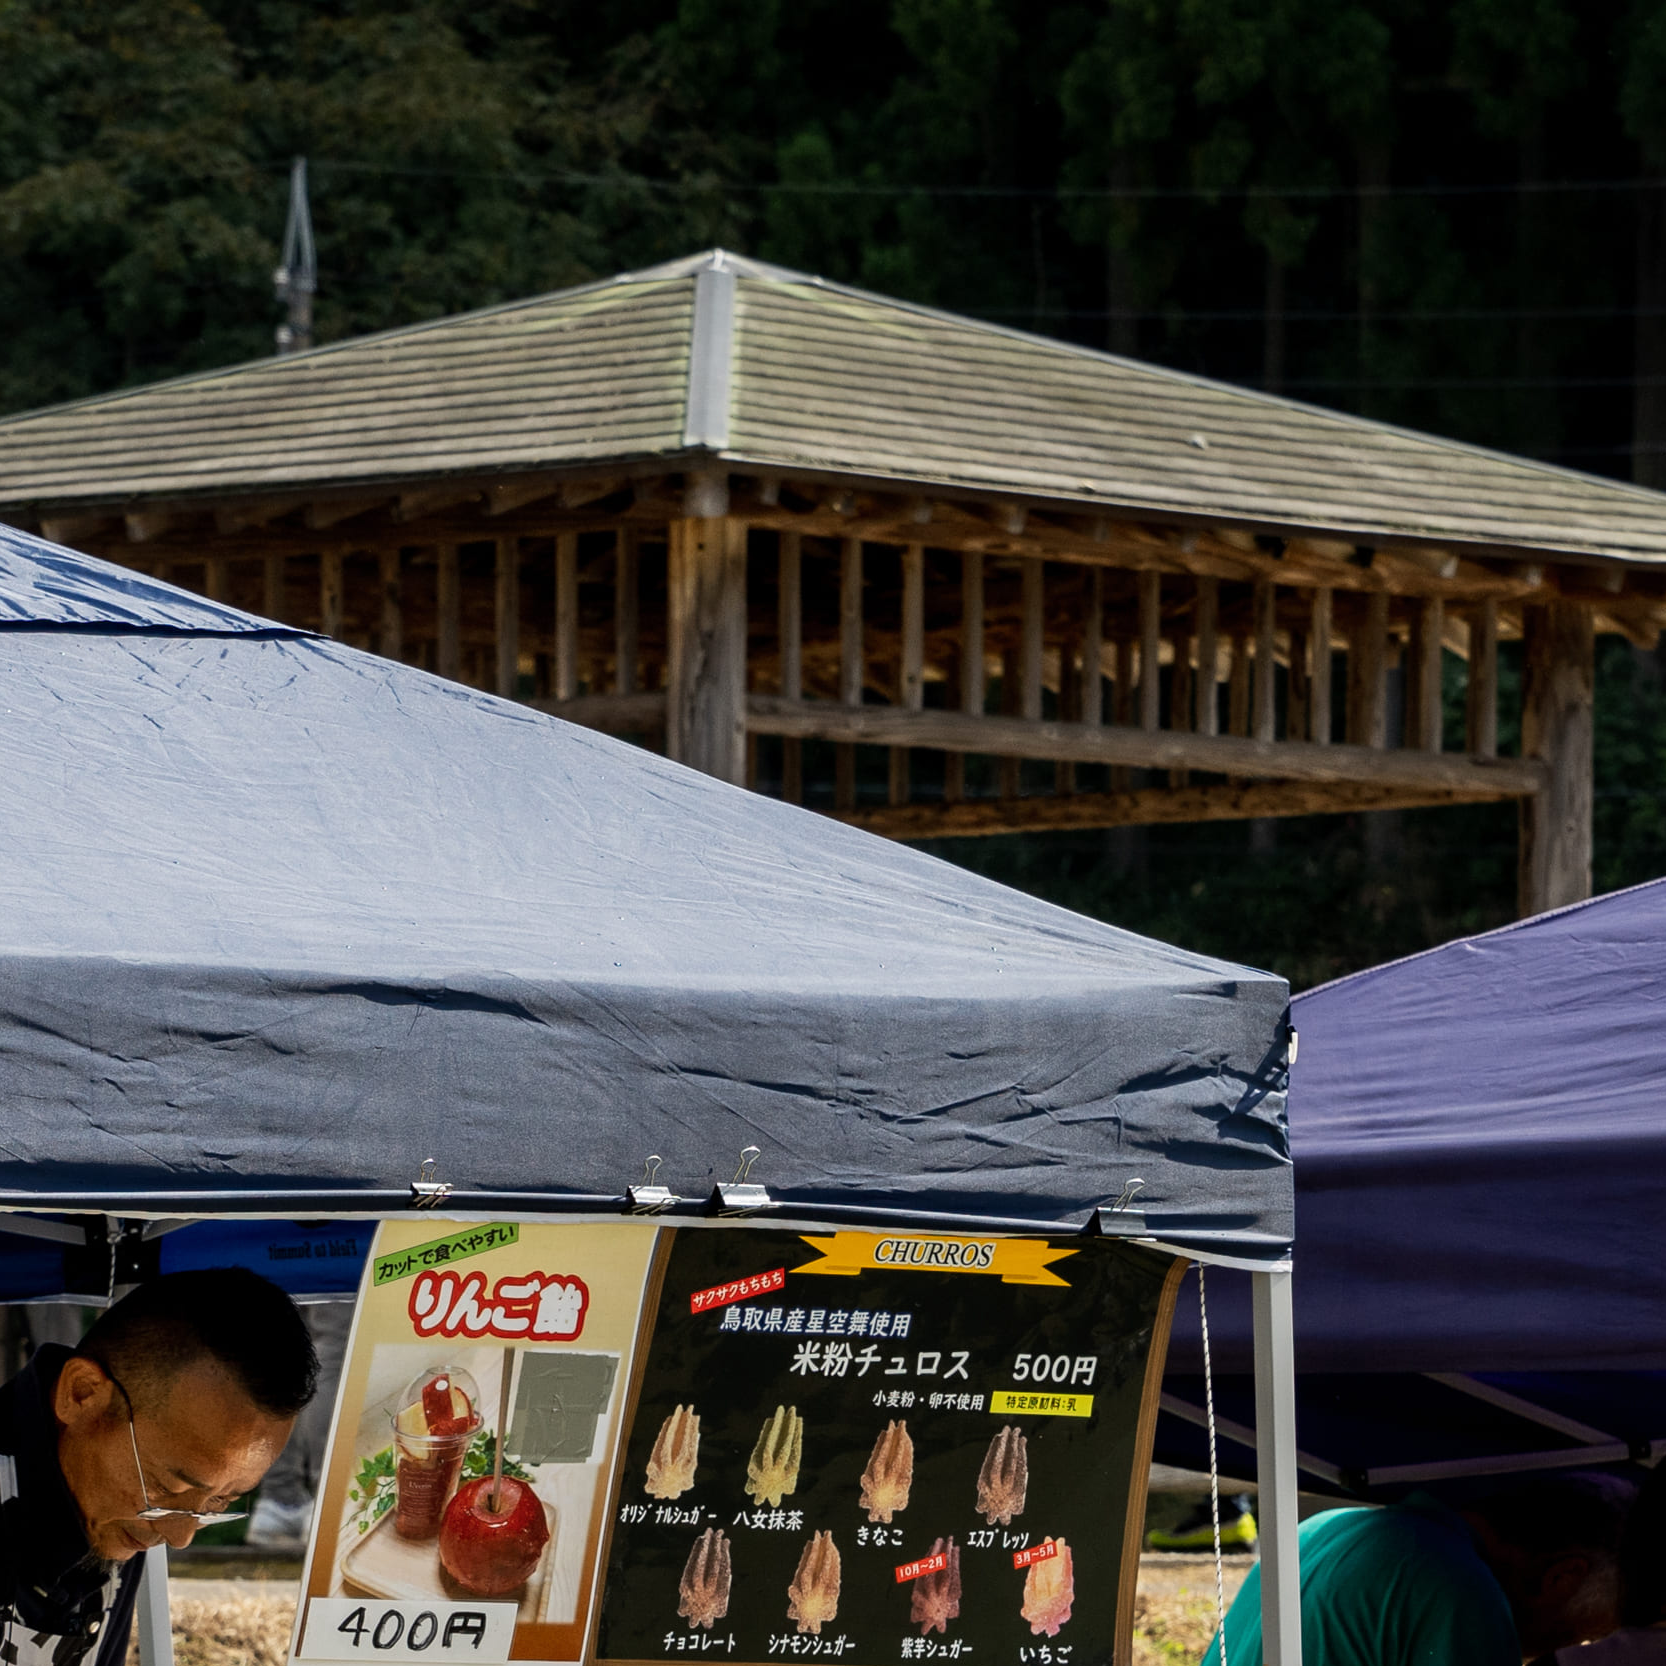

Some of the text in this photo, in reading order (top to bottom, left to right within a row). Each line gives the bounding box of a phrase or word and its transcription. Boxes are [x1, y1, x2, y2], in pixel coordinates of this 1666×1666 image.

[378, 1225, 517, 1281] カットで食べやすい
[874, 1240, 994, 1268] CHURROS
[693, 1271, 783, 1308] サクサクもちもち
[412, 1273, 585, 1338] りんご飴
[720, 1306, 911, 1338] 鳥取県産星空舞使用
[790, 1341, 1098, 1386] 米粉チュロス 500円
[873, 1391, 984, 1411] 小麦粉・卵不使用
[733, 1510, 804, 1531] 八女抹茶
[856, 1526, 903, 1546] きなこ
[967, 1530, 1030, 1550] エスプレッソ
[337, 1606, 487, 1651] 400円
[662, 1633, 736, 1653] チョコレート
[768, 1636, 856, 1658] シナモンシュガー
[901, 1638, 973, 1660] 紫芋シュガー
[1020, 1645, 1073, 1665] いちご
